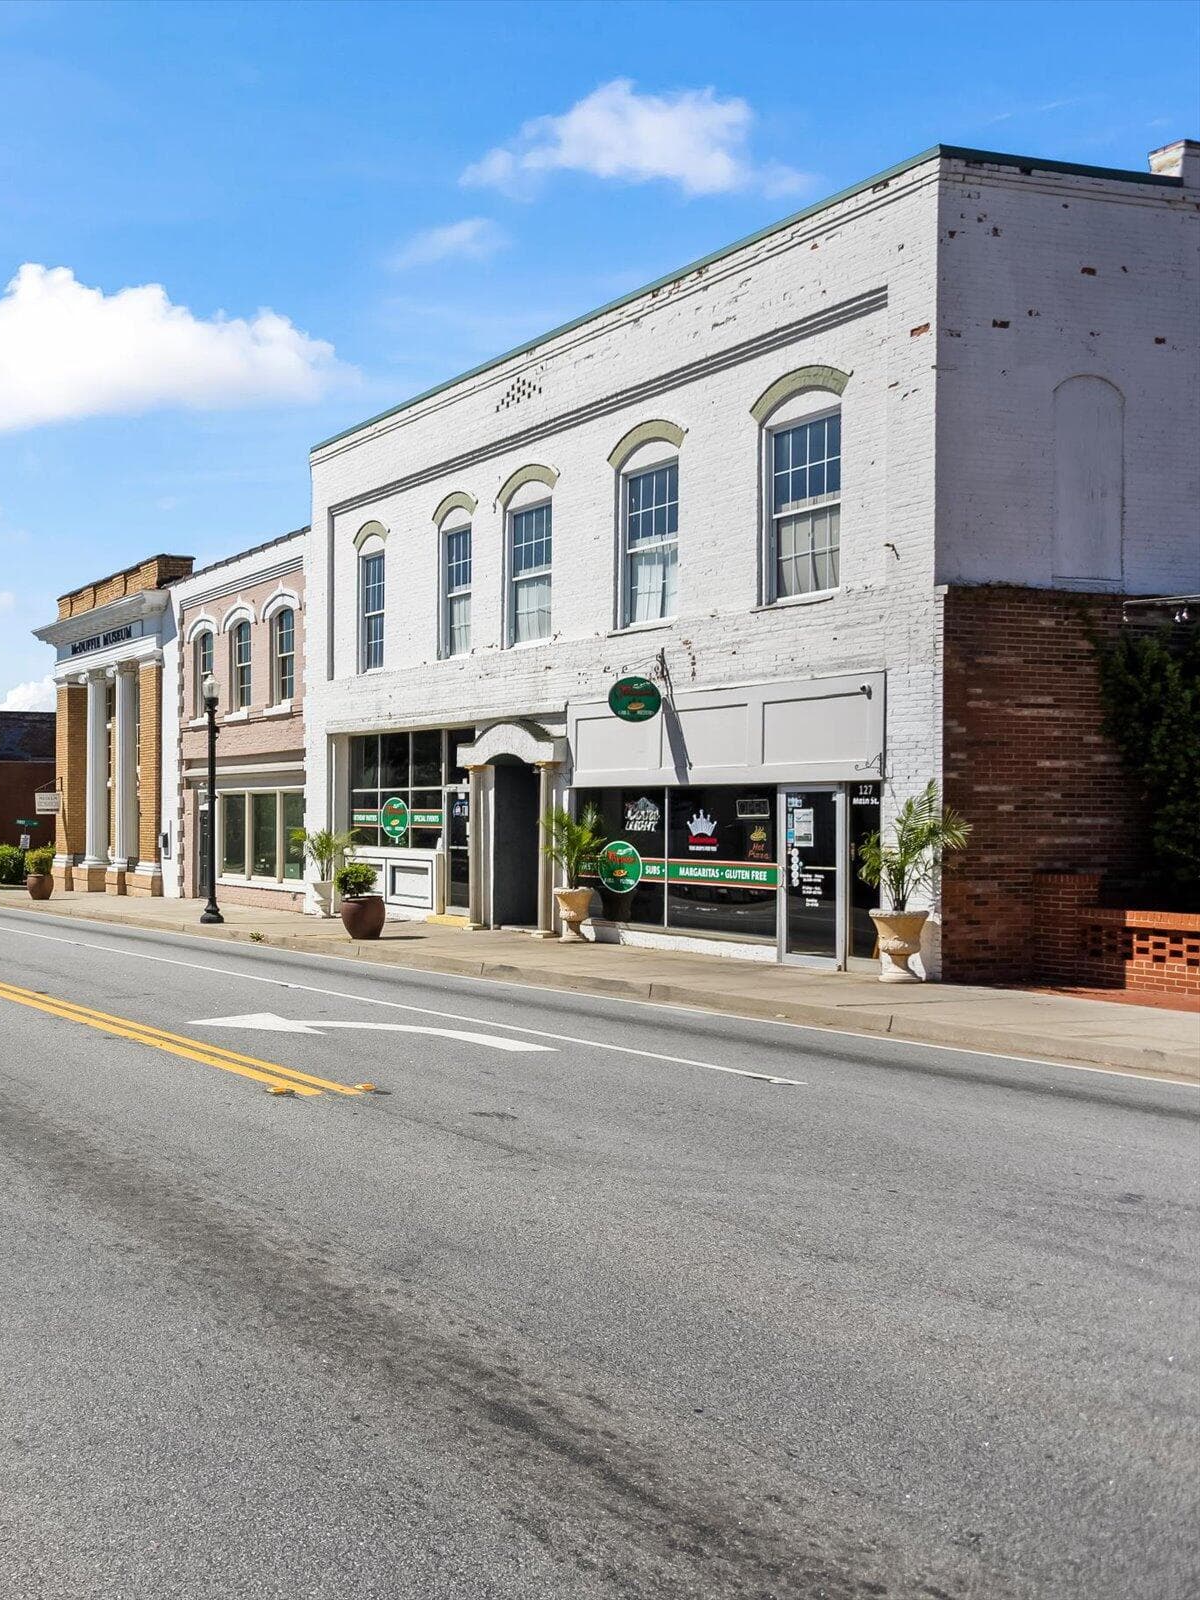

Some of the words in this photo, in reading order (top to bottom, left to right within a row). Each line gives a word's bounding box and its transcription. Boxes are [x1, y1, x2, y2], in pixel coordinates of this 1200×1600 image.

[102, 625, 132, 647] MUSEUM
[859, 785, 873, 795] 127
[852, 797, 870, 805] Main
[753, 843, 764, 851] Hot
[645, 865, 660, 875] SUBS
[679, 867, 719, 878] MARGARITAS
[724, 869, 750, 880] GLUTEN
[751, 871, 767, 881] FREE
